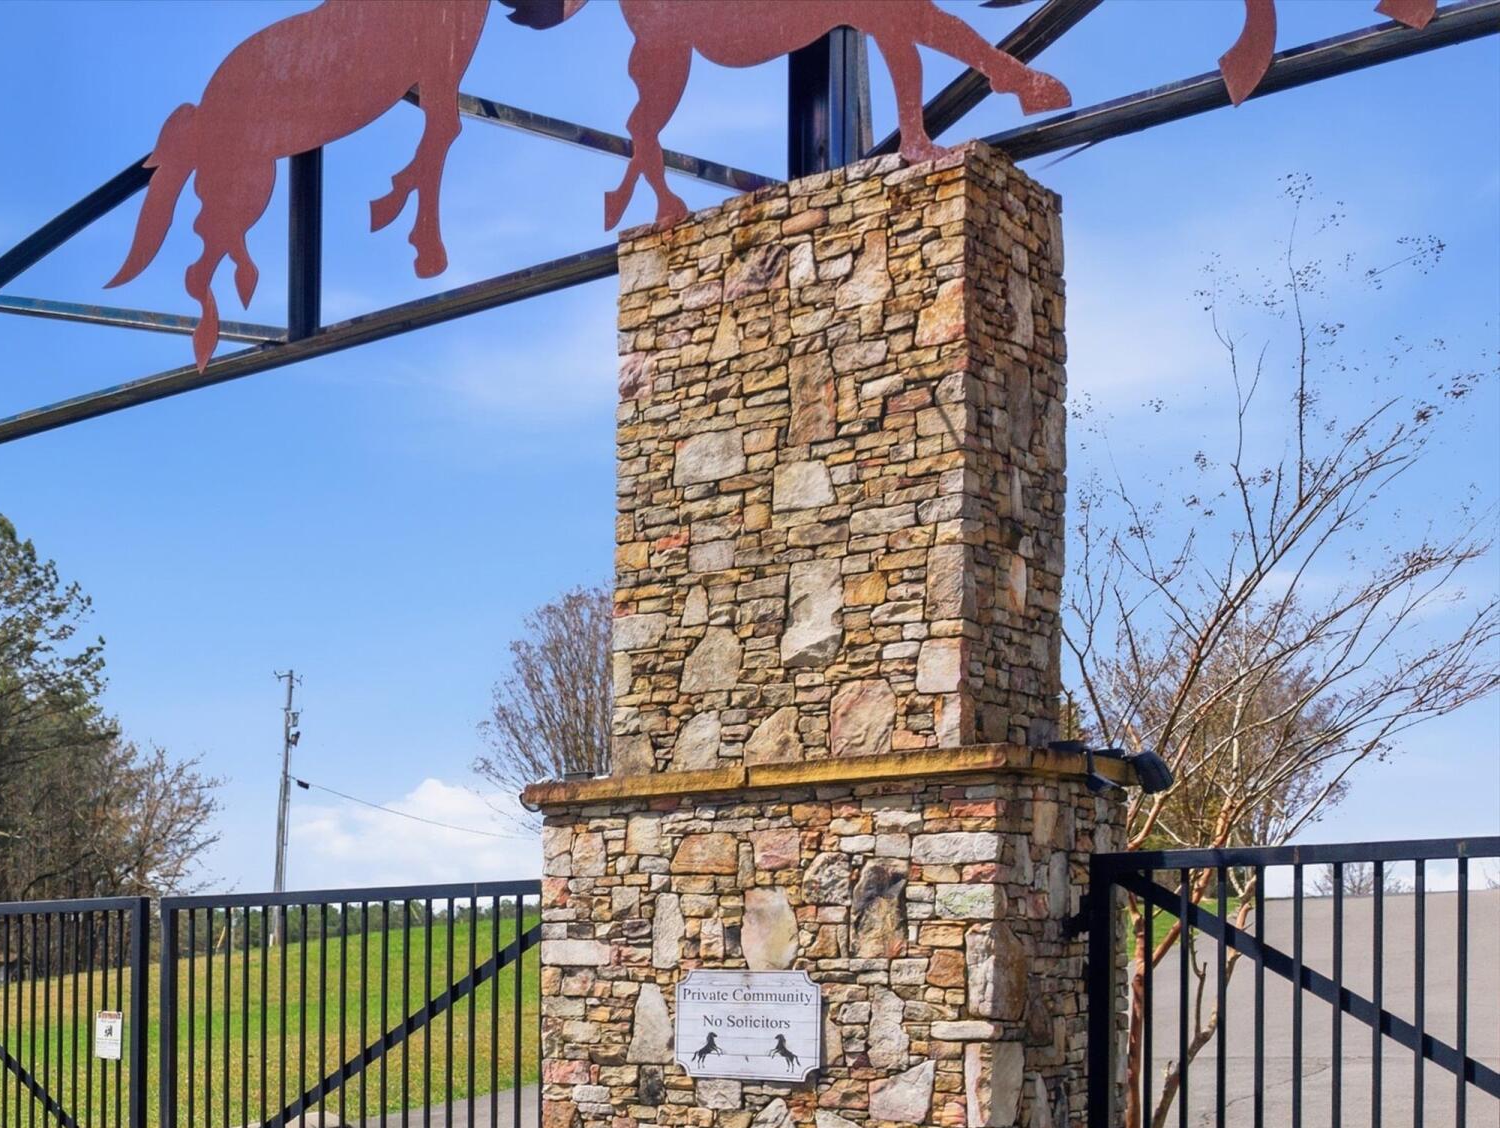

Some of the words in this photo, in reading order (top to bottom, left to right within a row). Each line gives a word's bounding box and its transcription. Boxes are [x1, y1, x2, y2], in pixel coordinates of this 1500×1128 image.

[683, 988, 729, 1001] Private
[732, 988, 813, 1006] Community
[703, 1015, 722, 1027] No
[726, 1015, 791, 1029] Solicitors
